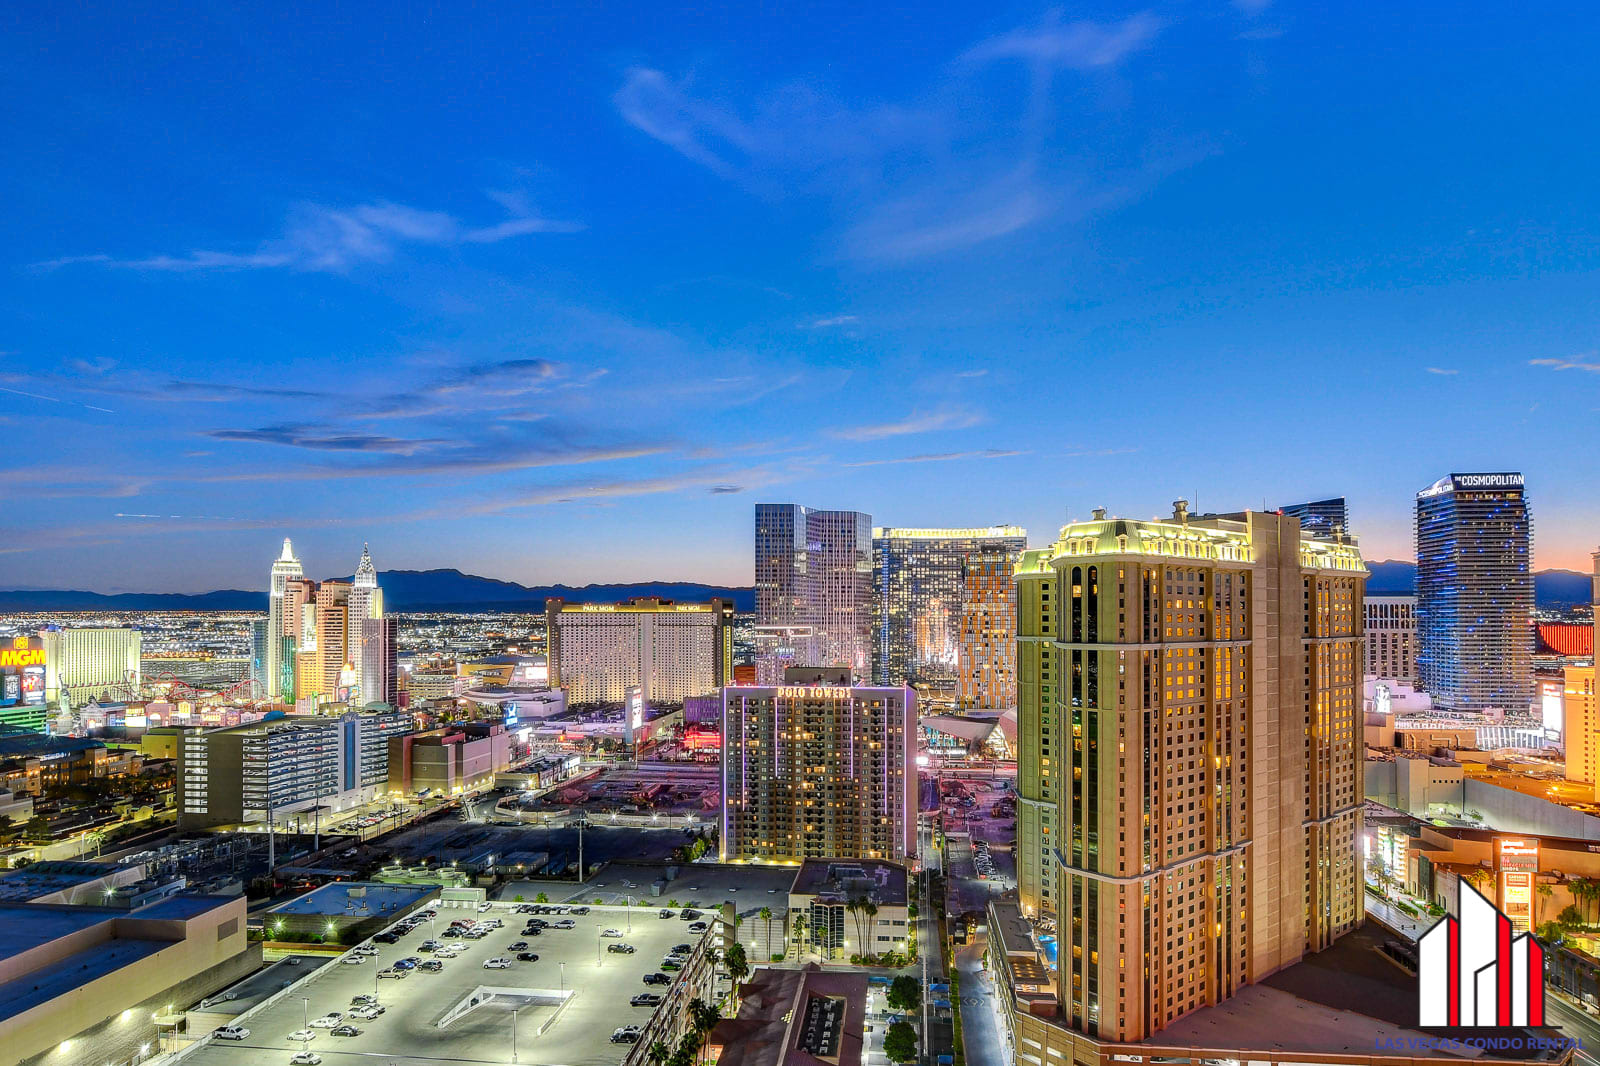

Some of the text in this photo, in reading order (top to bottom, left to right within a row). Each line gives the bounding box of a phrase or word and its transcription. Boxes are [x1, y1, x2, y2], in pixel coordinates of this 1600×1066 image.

[1462, 475, 1524, 486] COSMOPOLITAN
[0, 649, 46, 666] MGM
[777, 687, 805, 698] POLO
